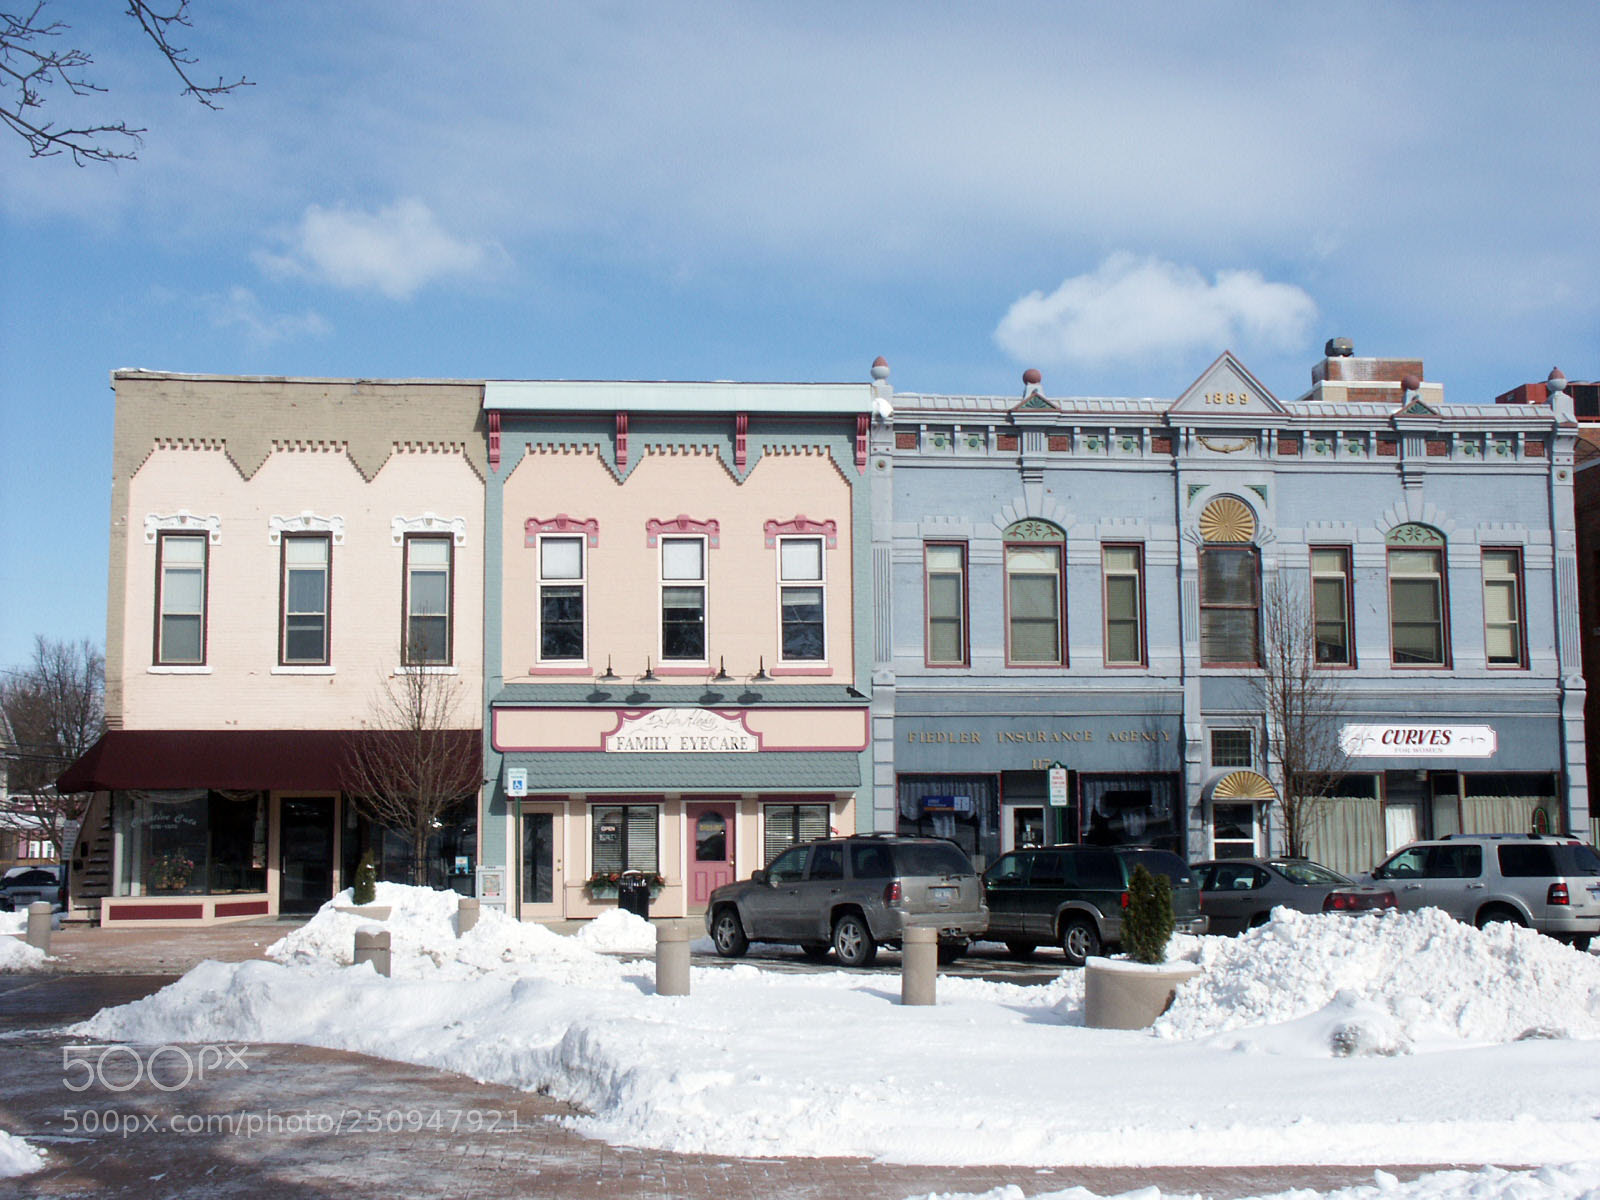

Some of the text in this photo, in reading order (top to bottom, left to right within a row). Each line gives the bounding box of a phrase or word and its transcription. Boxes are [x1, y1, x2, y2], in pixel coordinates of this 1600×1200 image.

[1205, 392, 1249, 405] 1889
[616, 737, 748, 750] FAMILY EYECARE
[908, 730, 1170, 744] FIEDLER INSURANCE AGENCY
[1381, 729, 1452, 745] CURVES
[1032, 759, 1051, 770] 117
